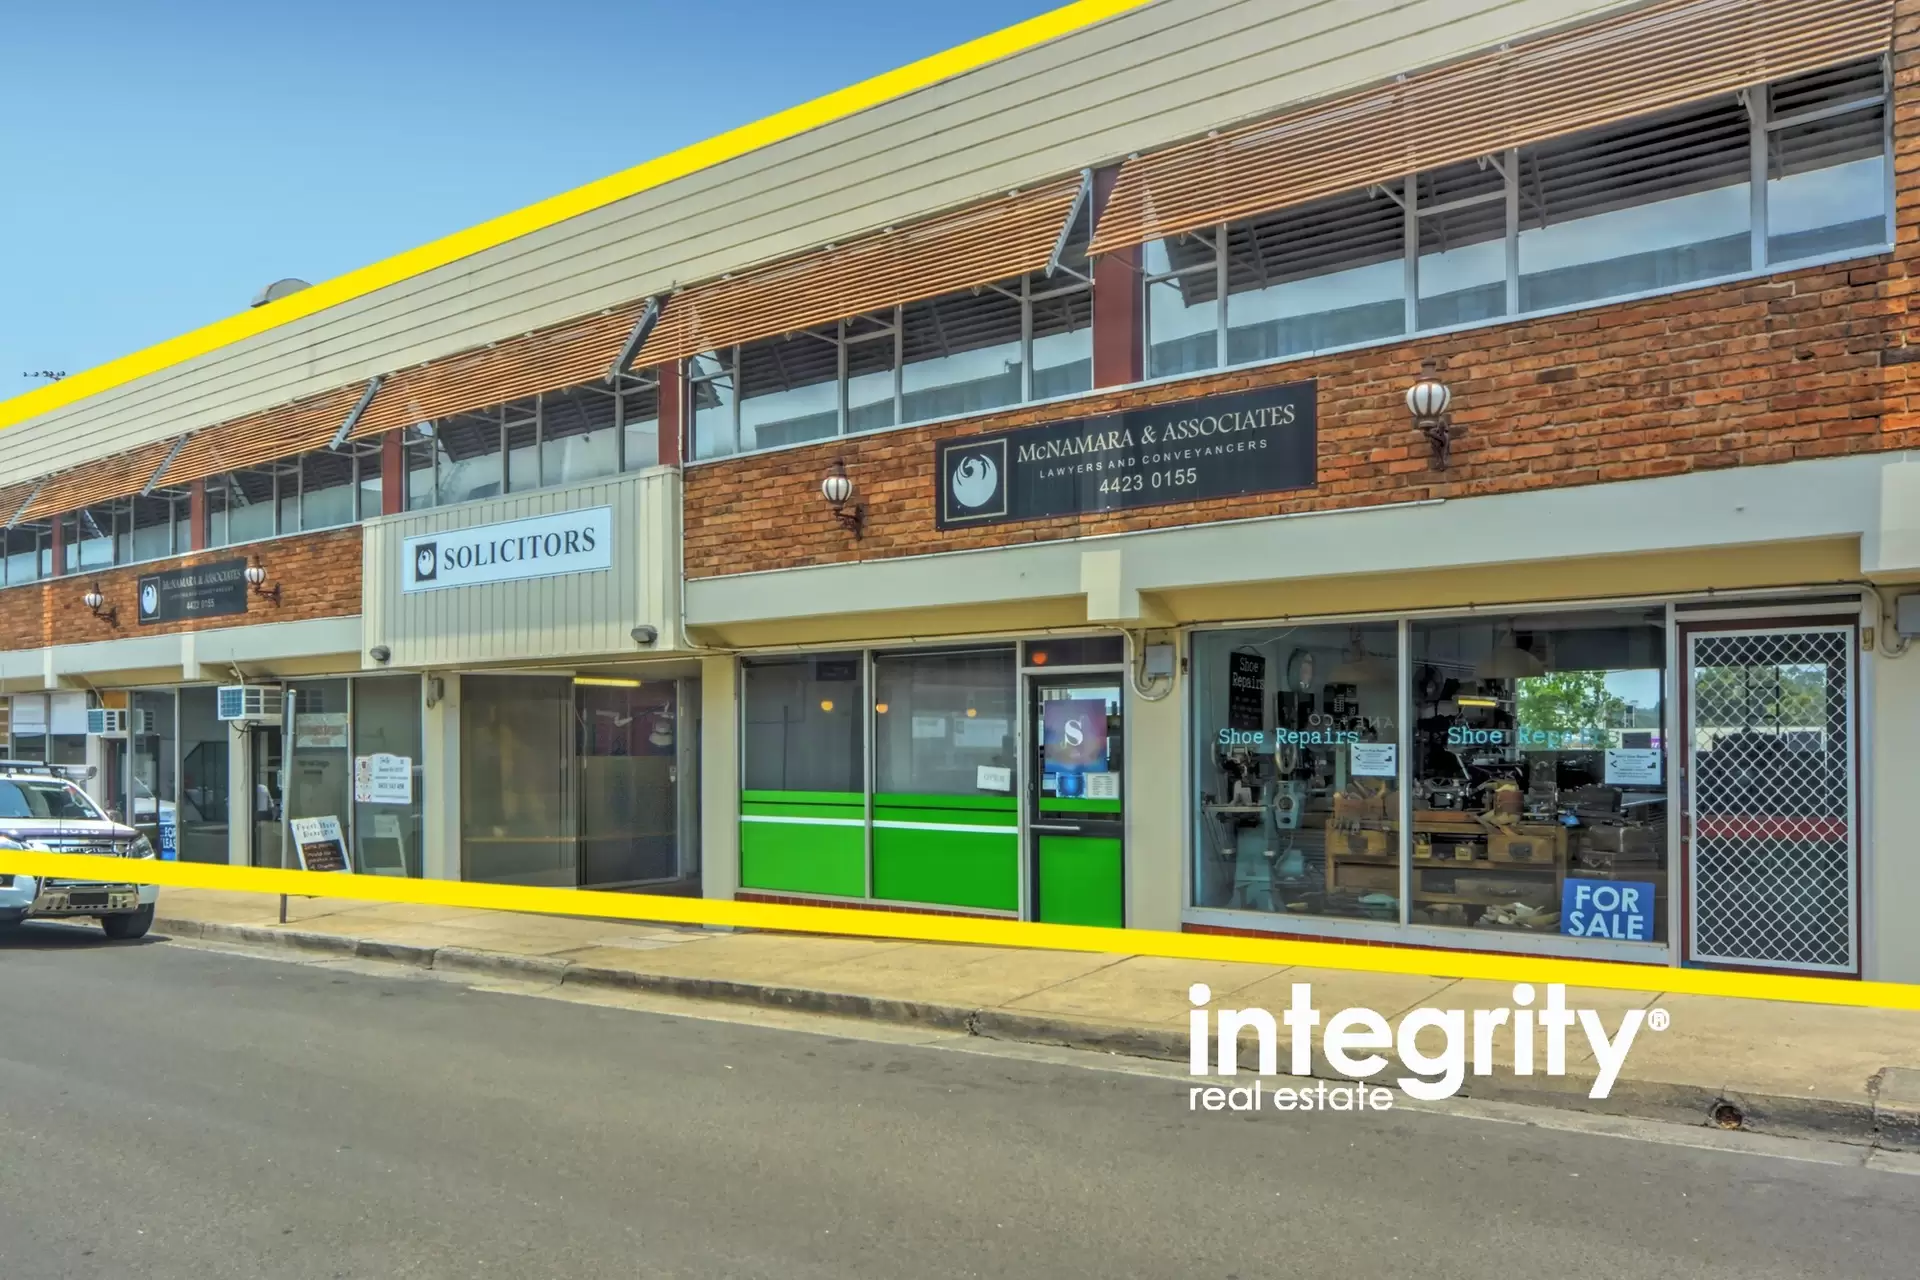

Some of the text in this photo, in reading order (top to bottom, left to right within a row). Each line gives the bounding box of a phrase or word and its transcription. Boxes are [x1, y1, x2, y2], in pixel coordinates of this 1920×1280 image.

[1017, 403, 1296, 464] McNAMARA & ASSOCIATES
[1039, 438, 1269, 479] LAWYERS AND CONVEYANCERS
[1099, 468, 1197, 495] 4423 0155
[444, 526, 596, 571] SOLICITORS
[1239, 656, 1260, 674] Shoe
[1232, 672, 1265, 692] Repairs
[1219, 727, 1360, 749] Shoe Repairs
[1447, 726, 1503, 744] Shoe
[1575, 885, 1640, 914] FOR
[1567, 910, 1645, 941] SALE
